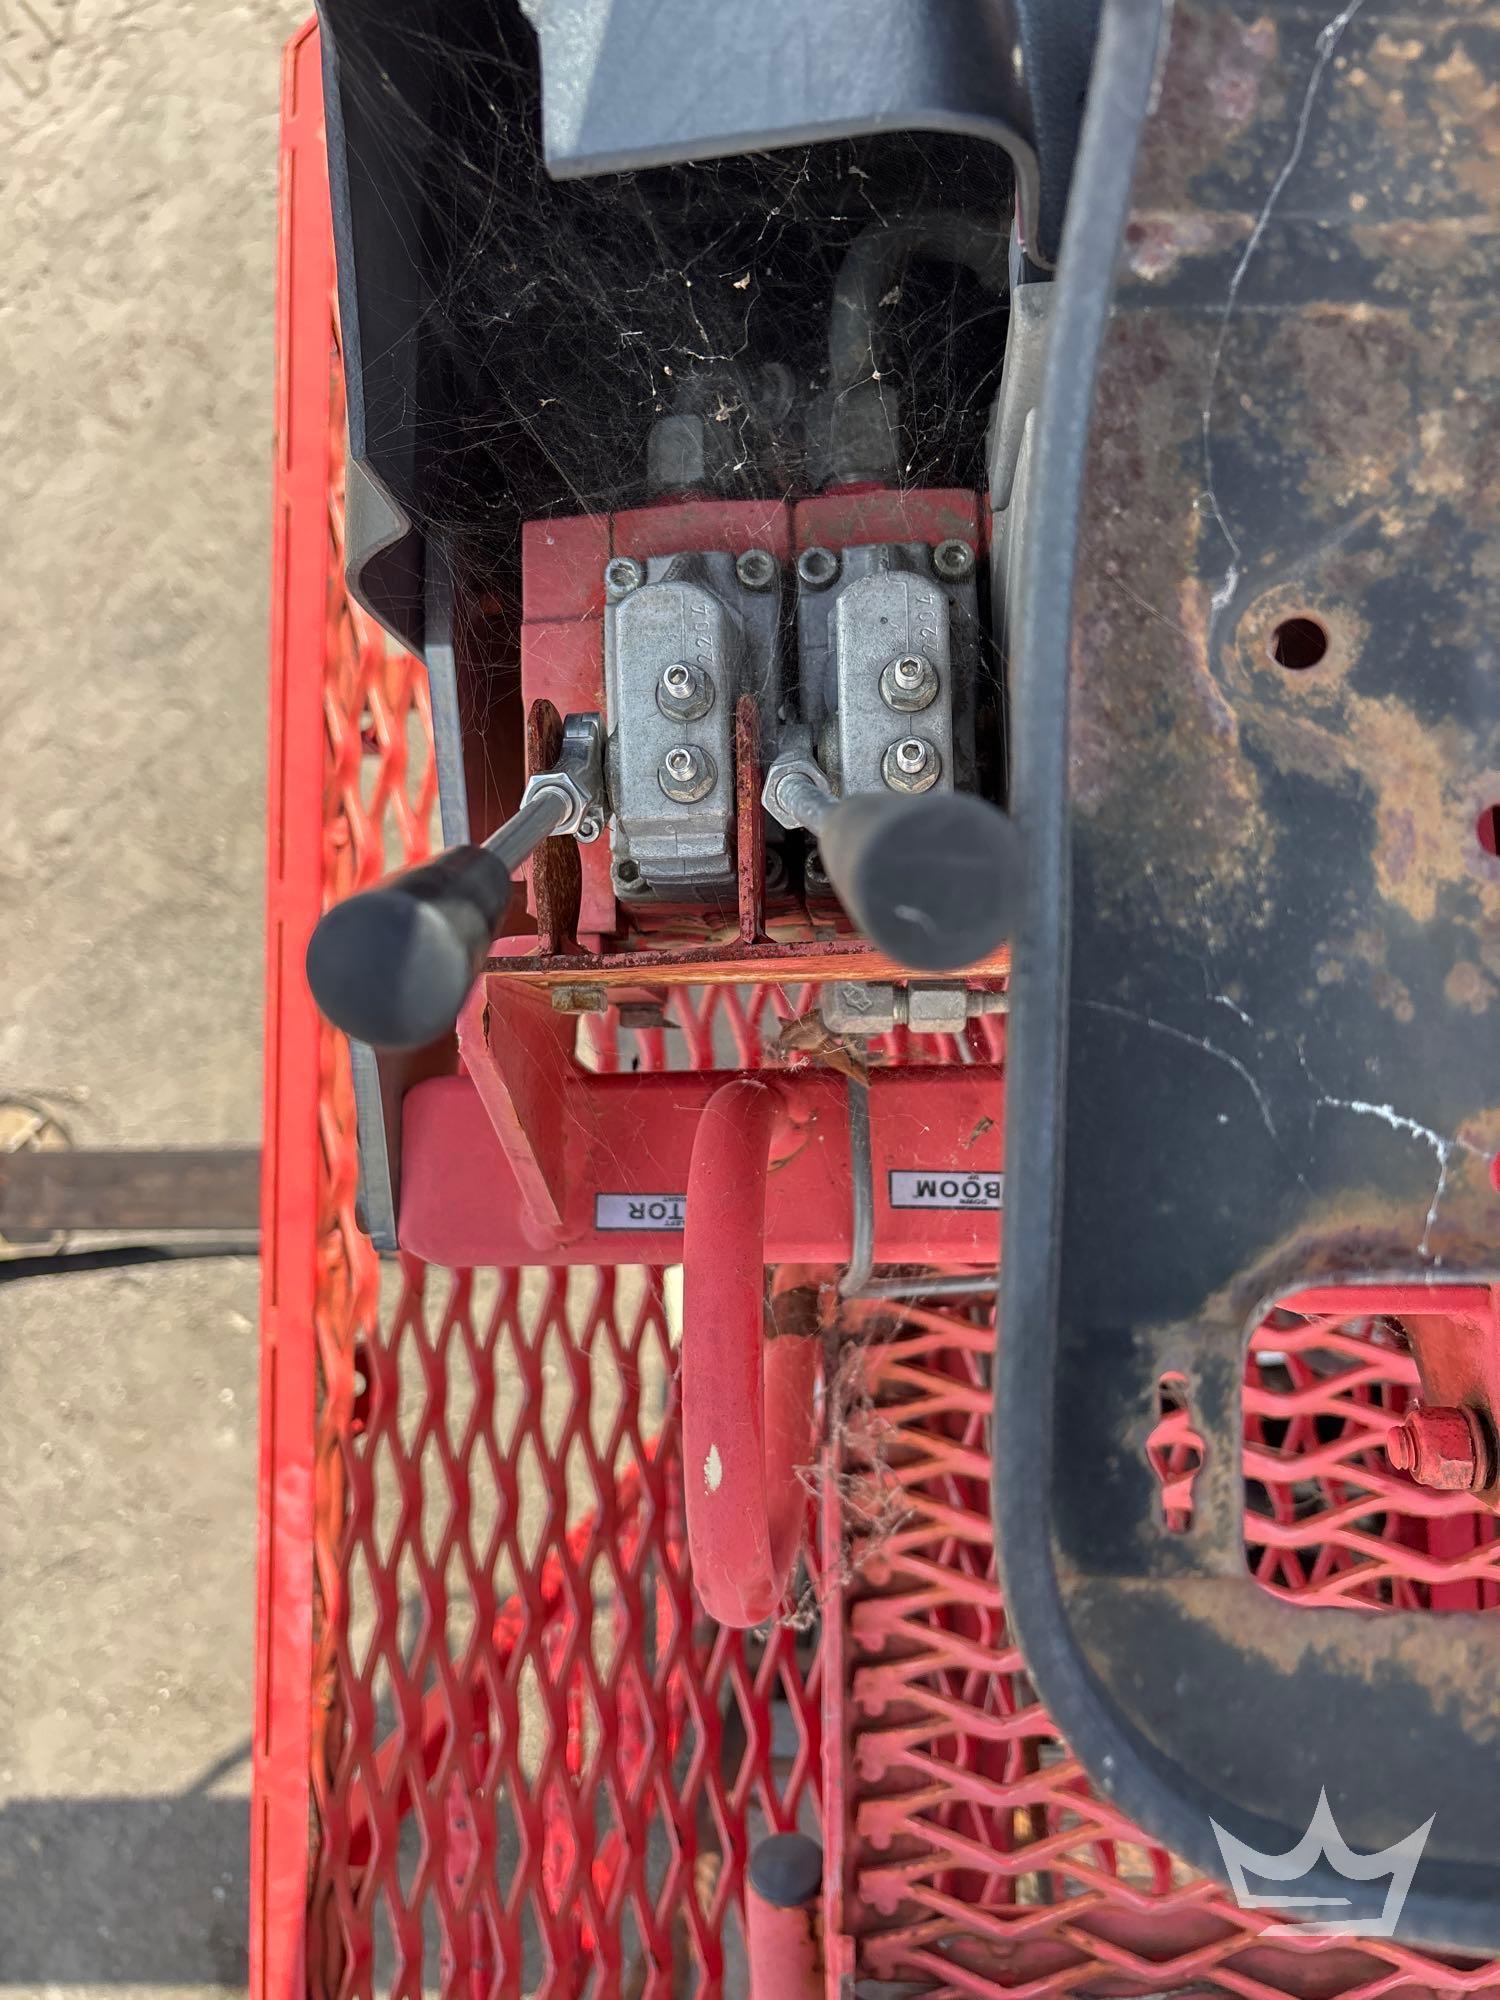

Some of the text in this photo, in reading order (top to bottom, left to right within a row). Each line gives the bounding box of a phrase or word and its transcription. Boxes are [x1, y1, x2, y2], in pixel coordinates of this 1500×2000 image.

[689, 603, 715, 664] 2204
[914, 592, 939, 655] 2204
[917, 1180, 1000, 1199] BOOM
